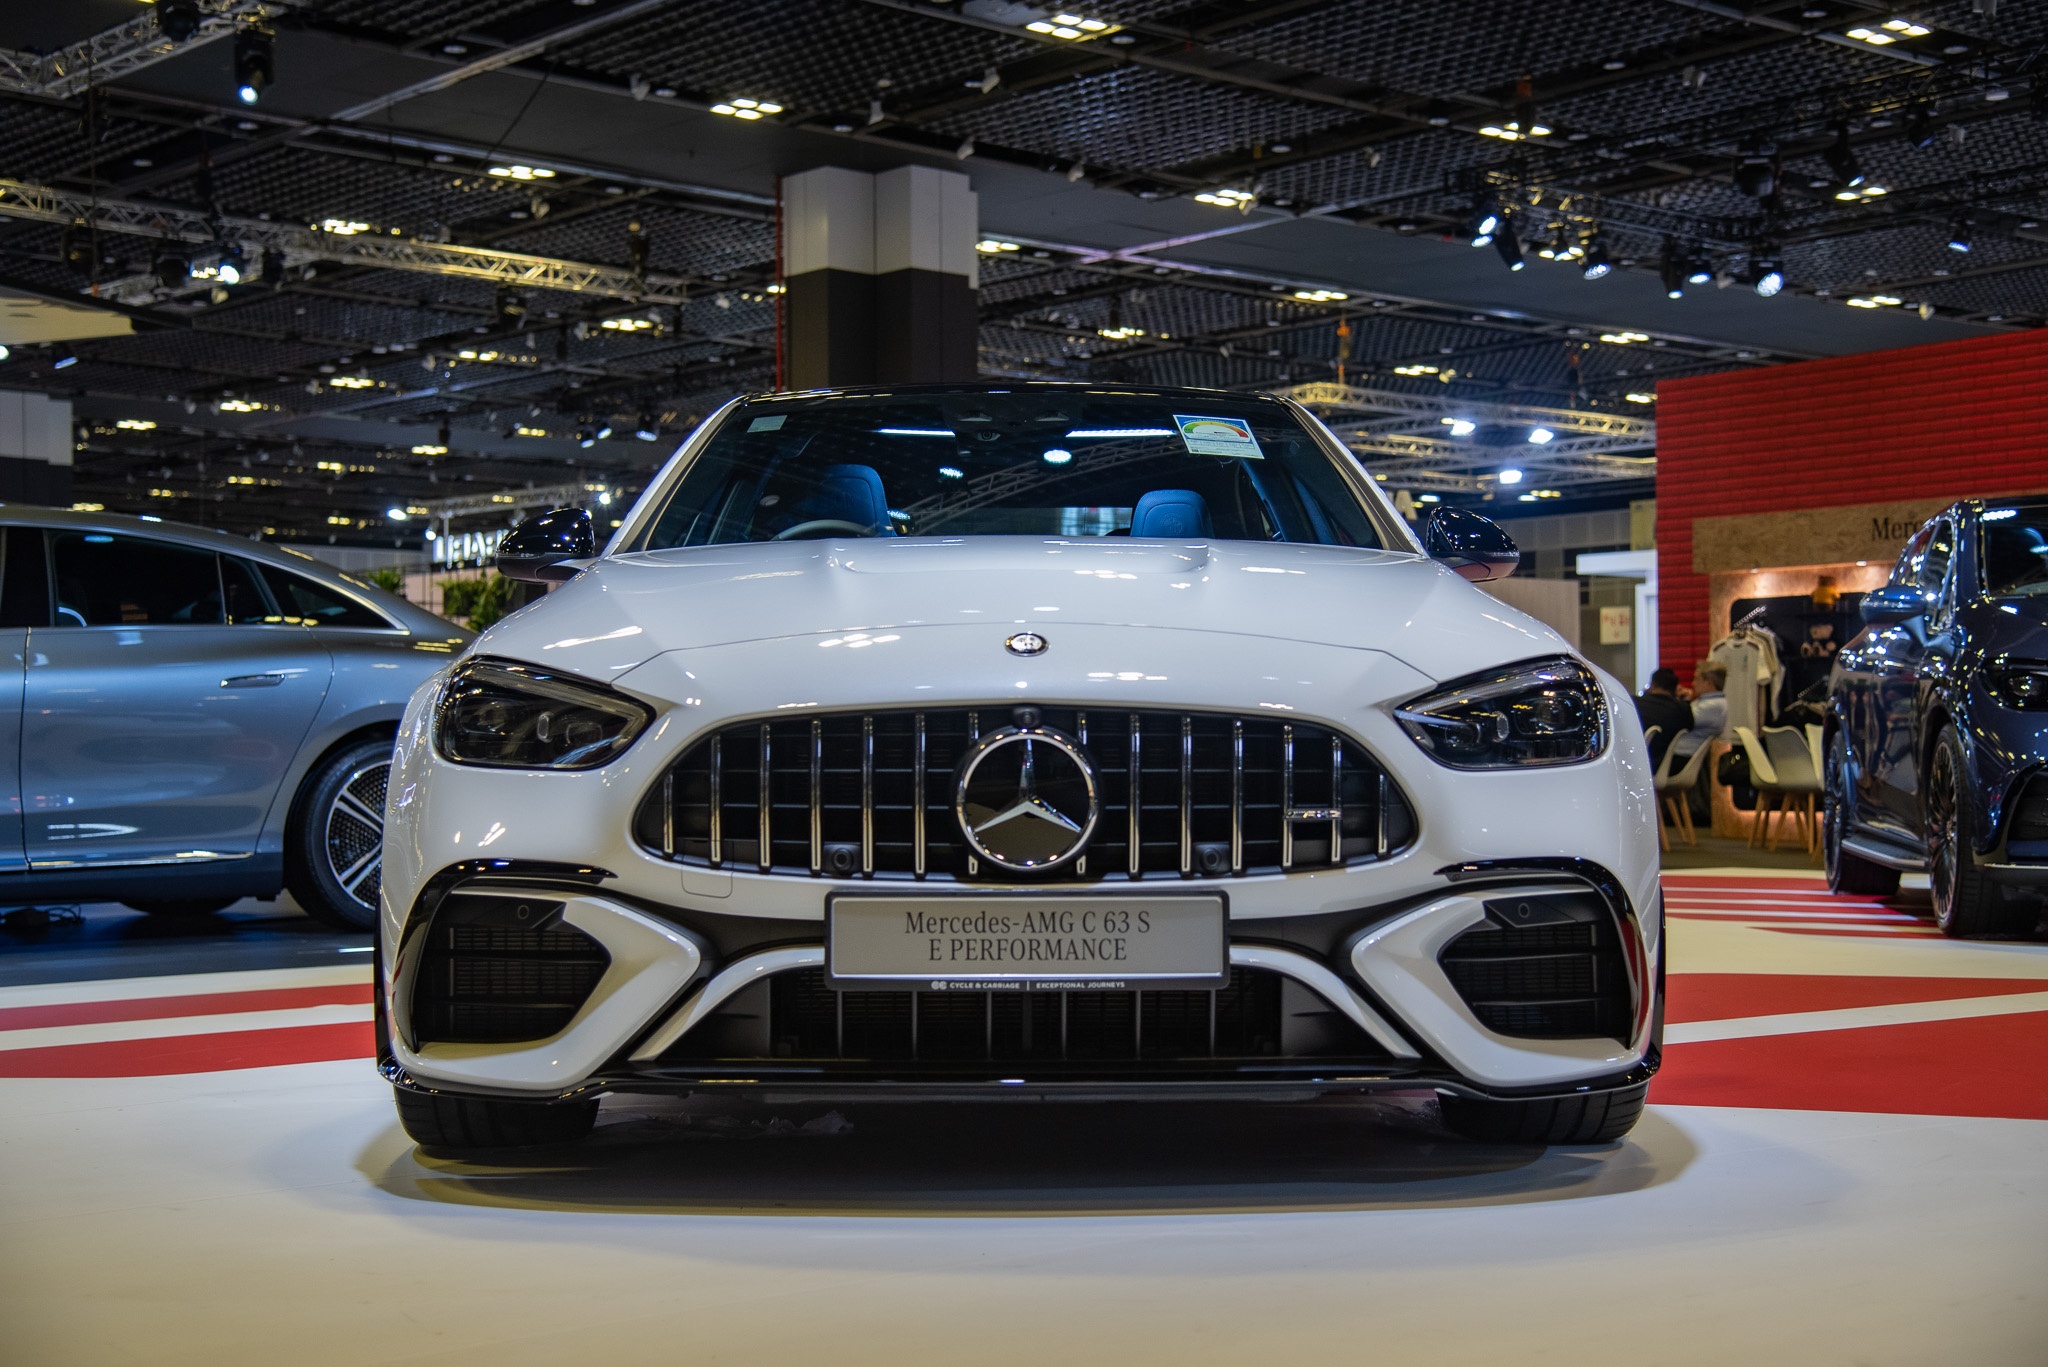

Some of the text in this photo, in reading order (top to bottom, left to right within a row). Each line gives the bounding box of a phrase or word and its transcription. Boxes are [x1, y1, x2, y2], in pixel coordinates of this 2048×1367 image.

[905, 910, 1150, 934] Mercedes-AMG C 63 S
[929, 937, 1127, 961] E PERFORMANCE
[1087, 981, 1126, 989] JOURNEYS
